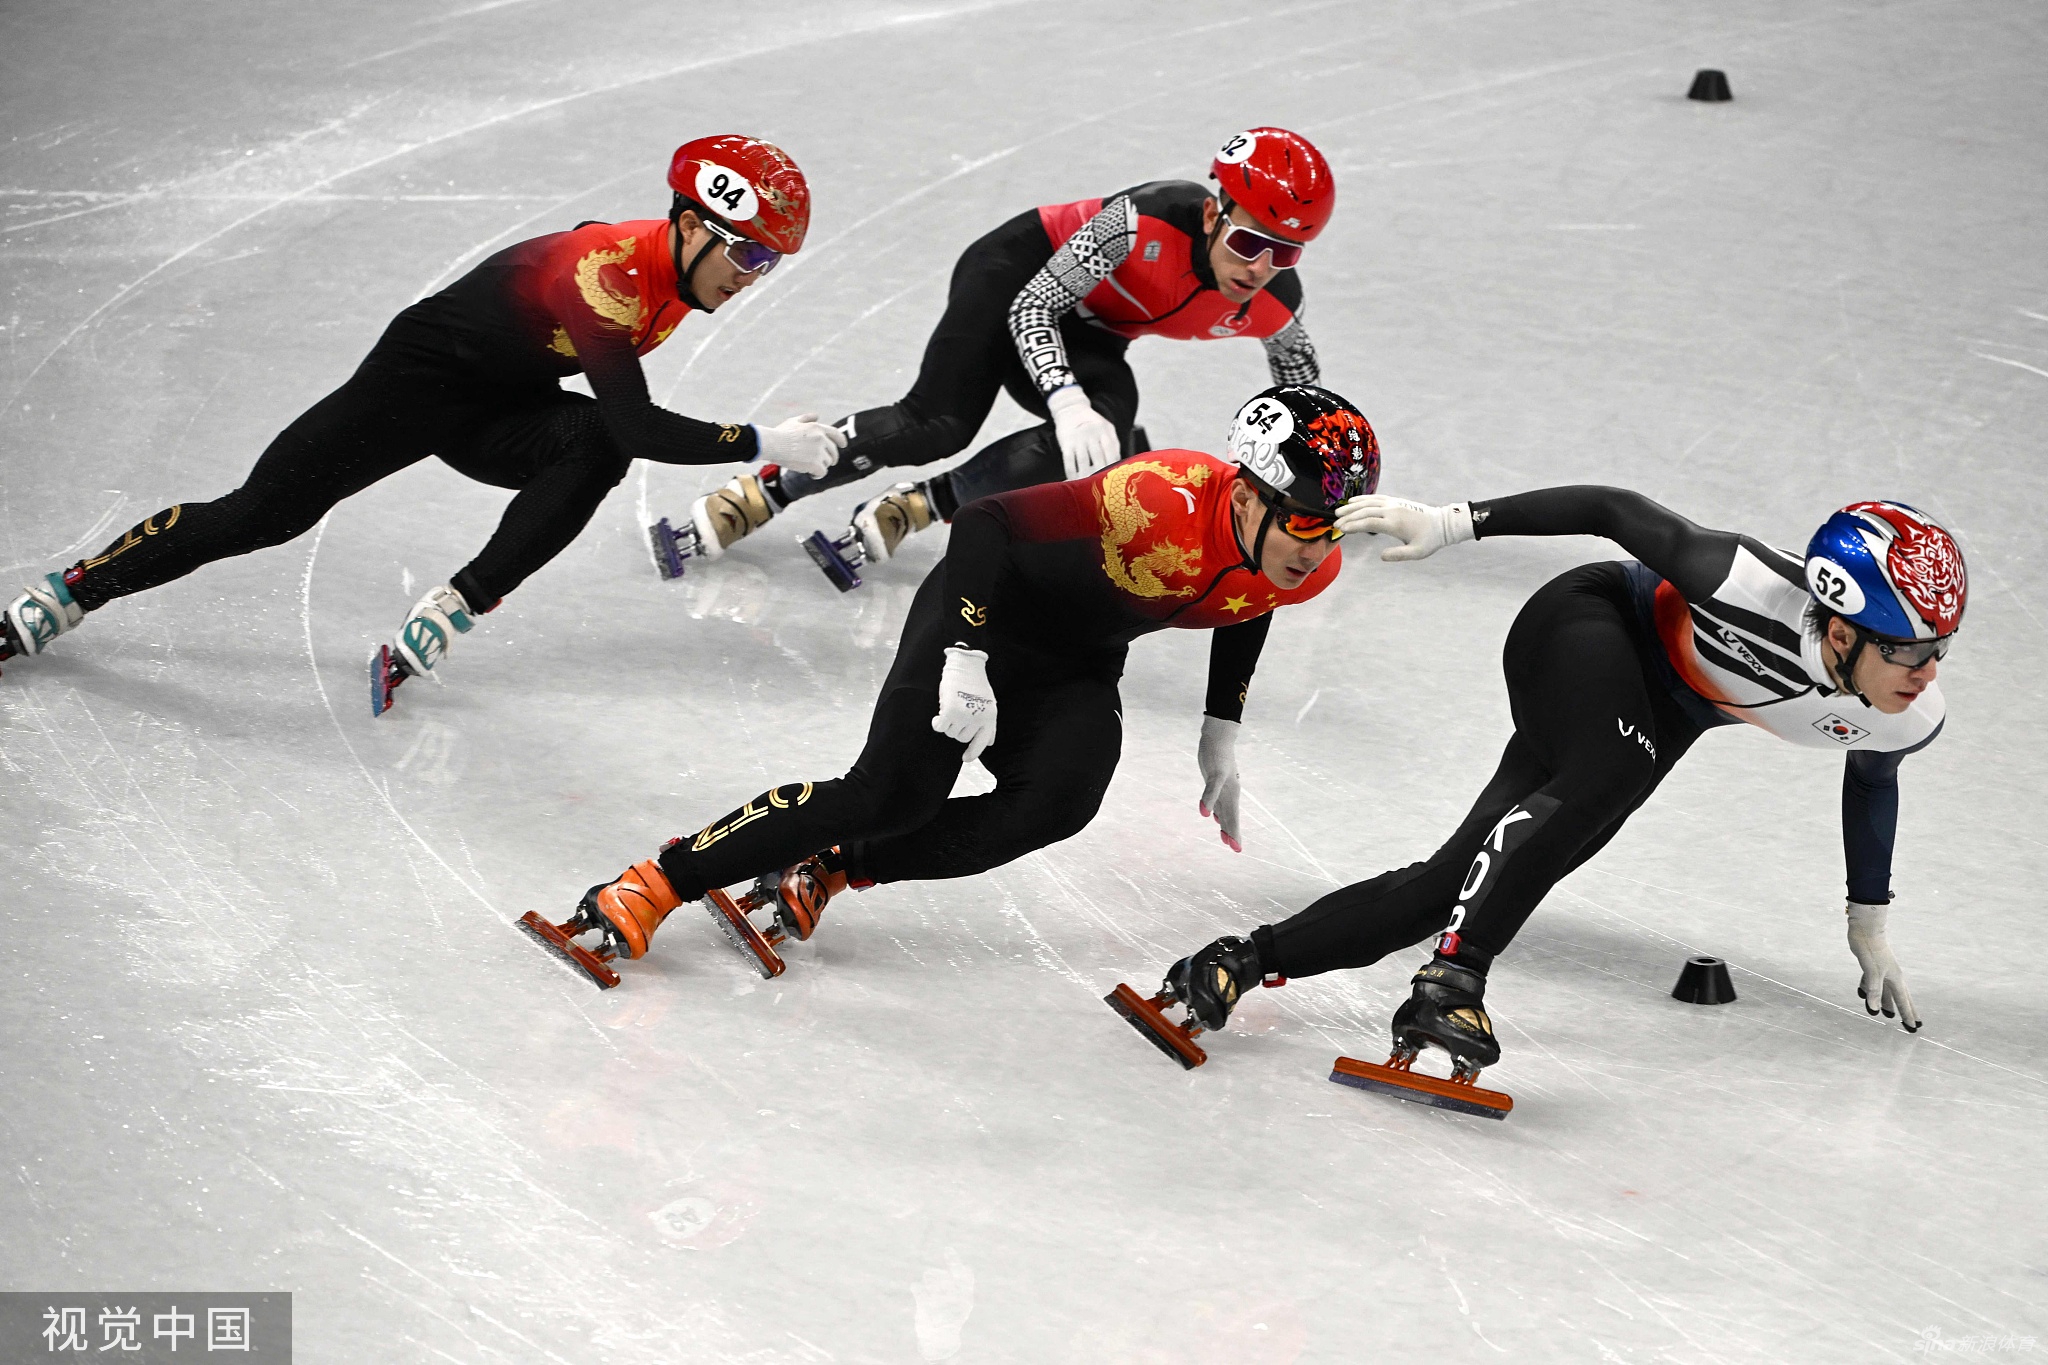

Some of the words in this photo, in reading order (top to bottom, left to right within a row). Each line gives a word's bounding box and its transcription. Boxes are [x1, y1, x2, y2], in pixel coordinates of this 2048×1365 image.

[707, 173, 746, 211] 94
[1245, 402, 1283, 435] 54
[1815, 567, 1847, 608] 52
